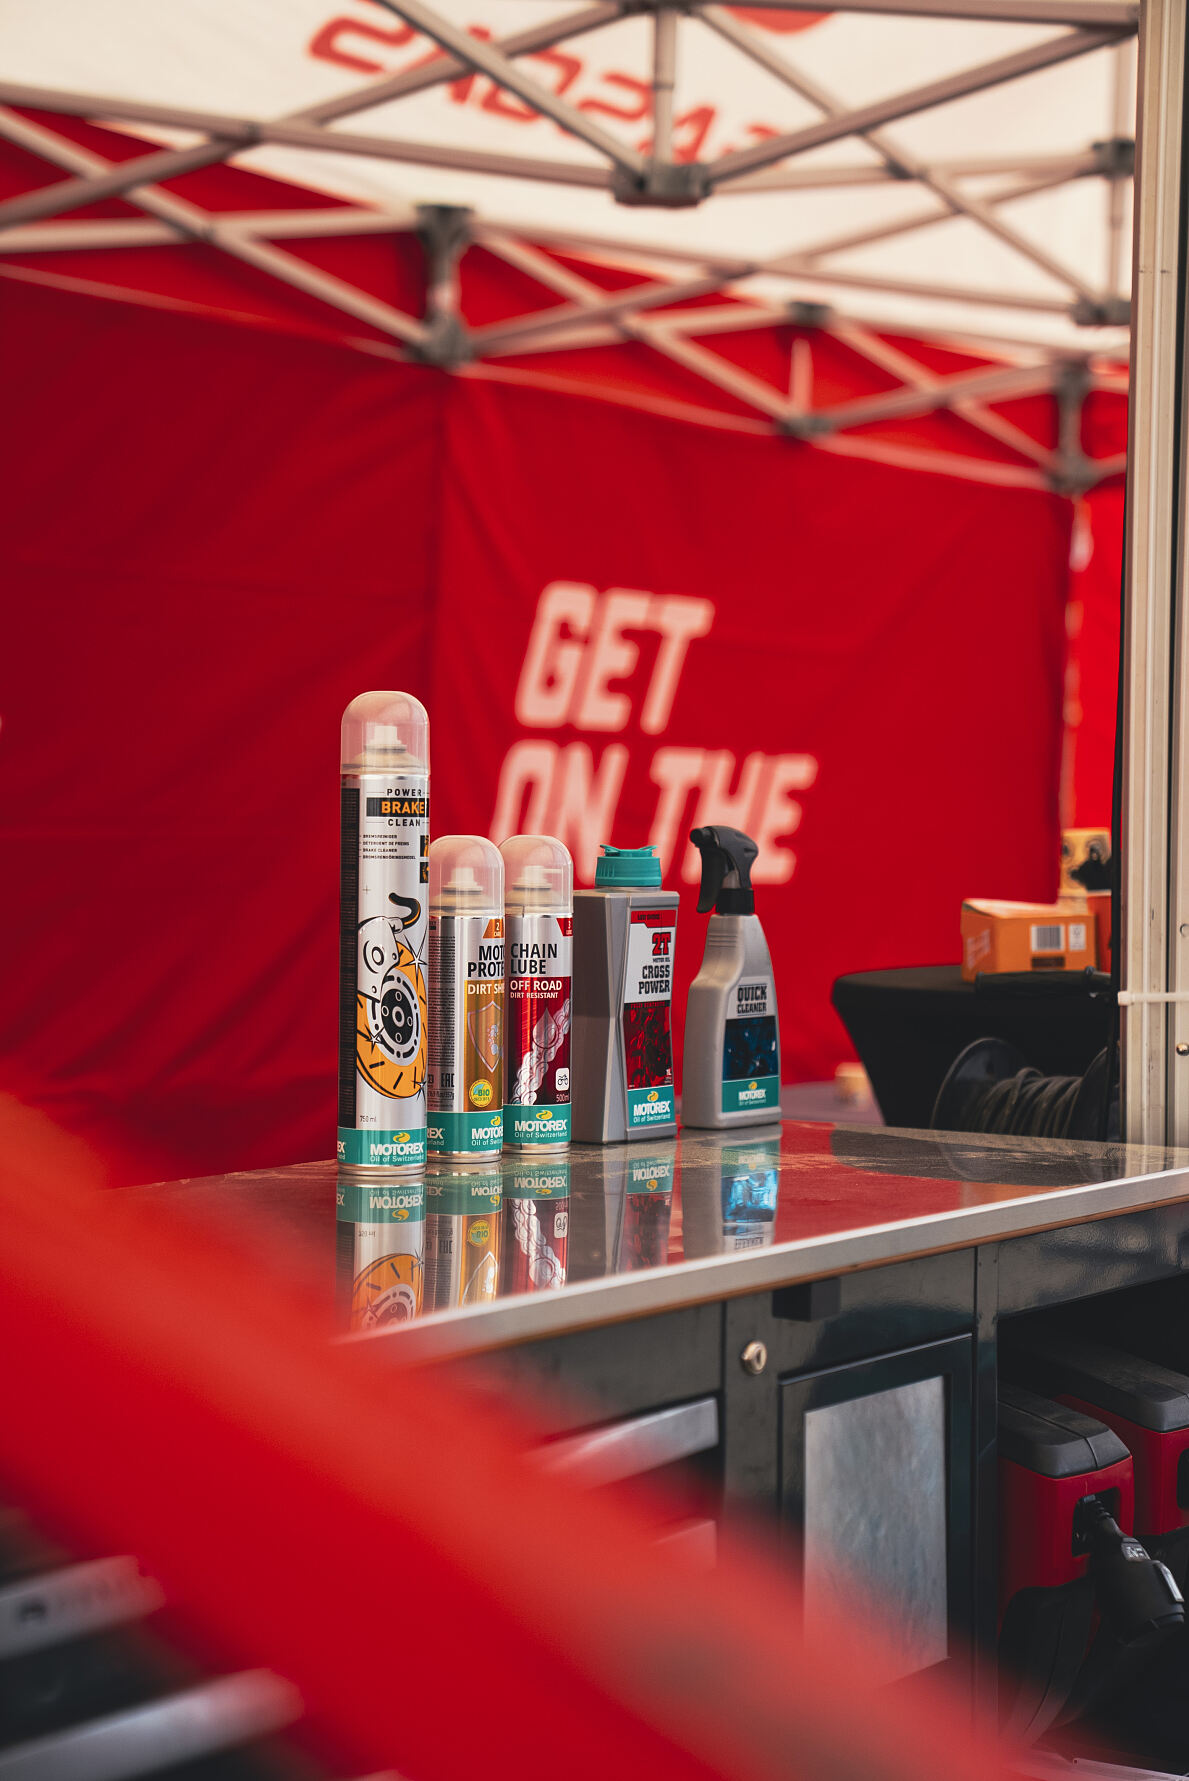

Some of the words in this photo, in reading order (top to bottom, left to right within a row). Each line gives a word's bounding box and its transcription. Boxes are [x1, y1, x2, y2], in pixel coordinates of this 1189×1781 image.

[515, 580, 715, 735] GET
[387, 788, 422, 797] POWER
[381, 801, 425, 814] BRAKE
[489, 739, 630, 885] ON
[650, 746, 818, 885] THE
[388, 818, 421, 827] CLEAN
[495, 922, 501, 931] 2
[652, 932, 671, 956] 2T
[479, 944, 505, 961] MOT
[510, 943, 558, 959] CHAIN
[510, 960, 546, 975] LUBE
[642, 964, 670, 979] CROSS
[467, 984, 493, 995] DIRT
[510, 980, 531, 991] OFF
[533, 980, 563, 991] ROAD
[638, 980, 670, 995] POWER
[510, 991, 525, 999] DIRT
[526, 991, 559, 999] RESISTANT
[737, 985, 768, 1002] QUICK
[737, 1001, 767, 1014] CLEANER
[477, 1088, 490, 1097] BIO
[633, 1100, 671, 1117] MOTOREX
[514, 1119, 568, 1132] MOTOREX
[534, 1130, 568, 1138] Switzerland
[370, 1141, 425, 1156] MOTOREX
[482, 1138, 489, 1146] of
[382, 1154, 390, 1162] of
[392, 1153, 425, 1162] Switzerland
